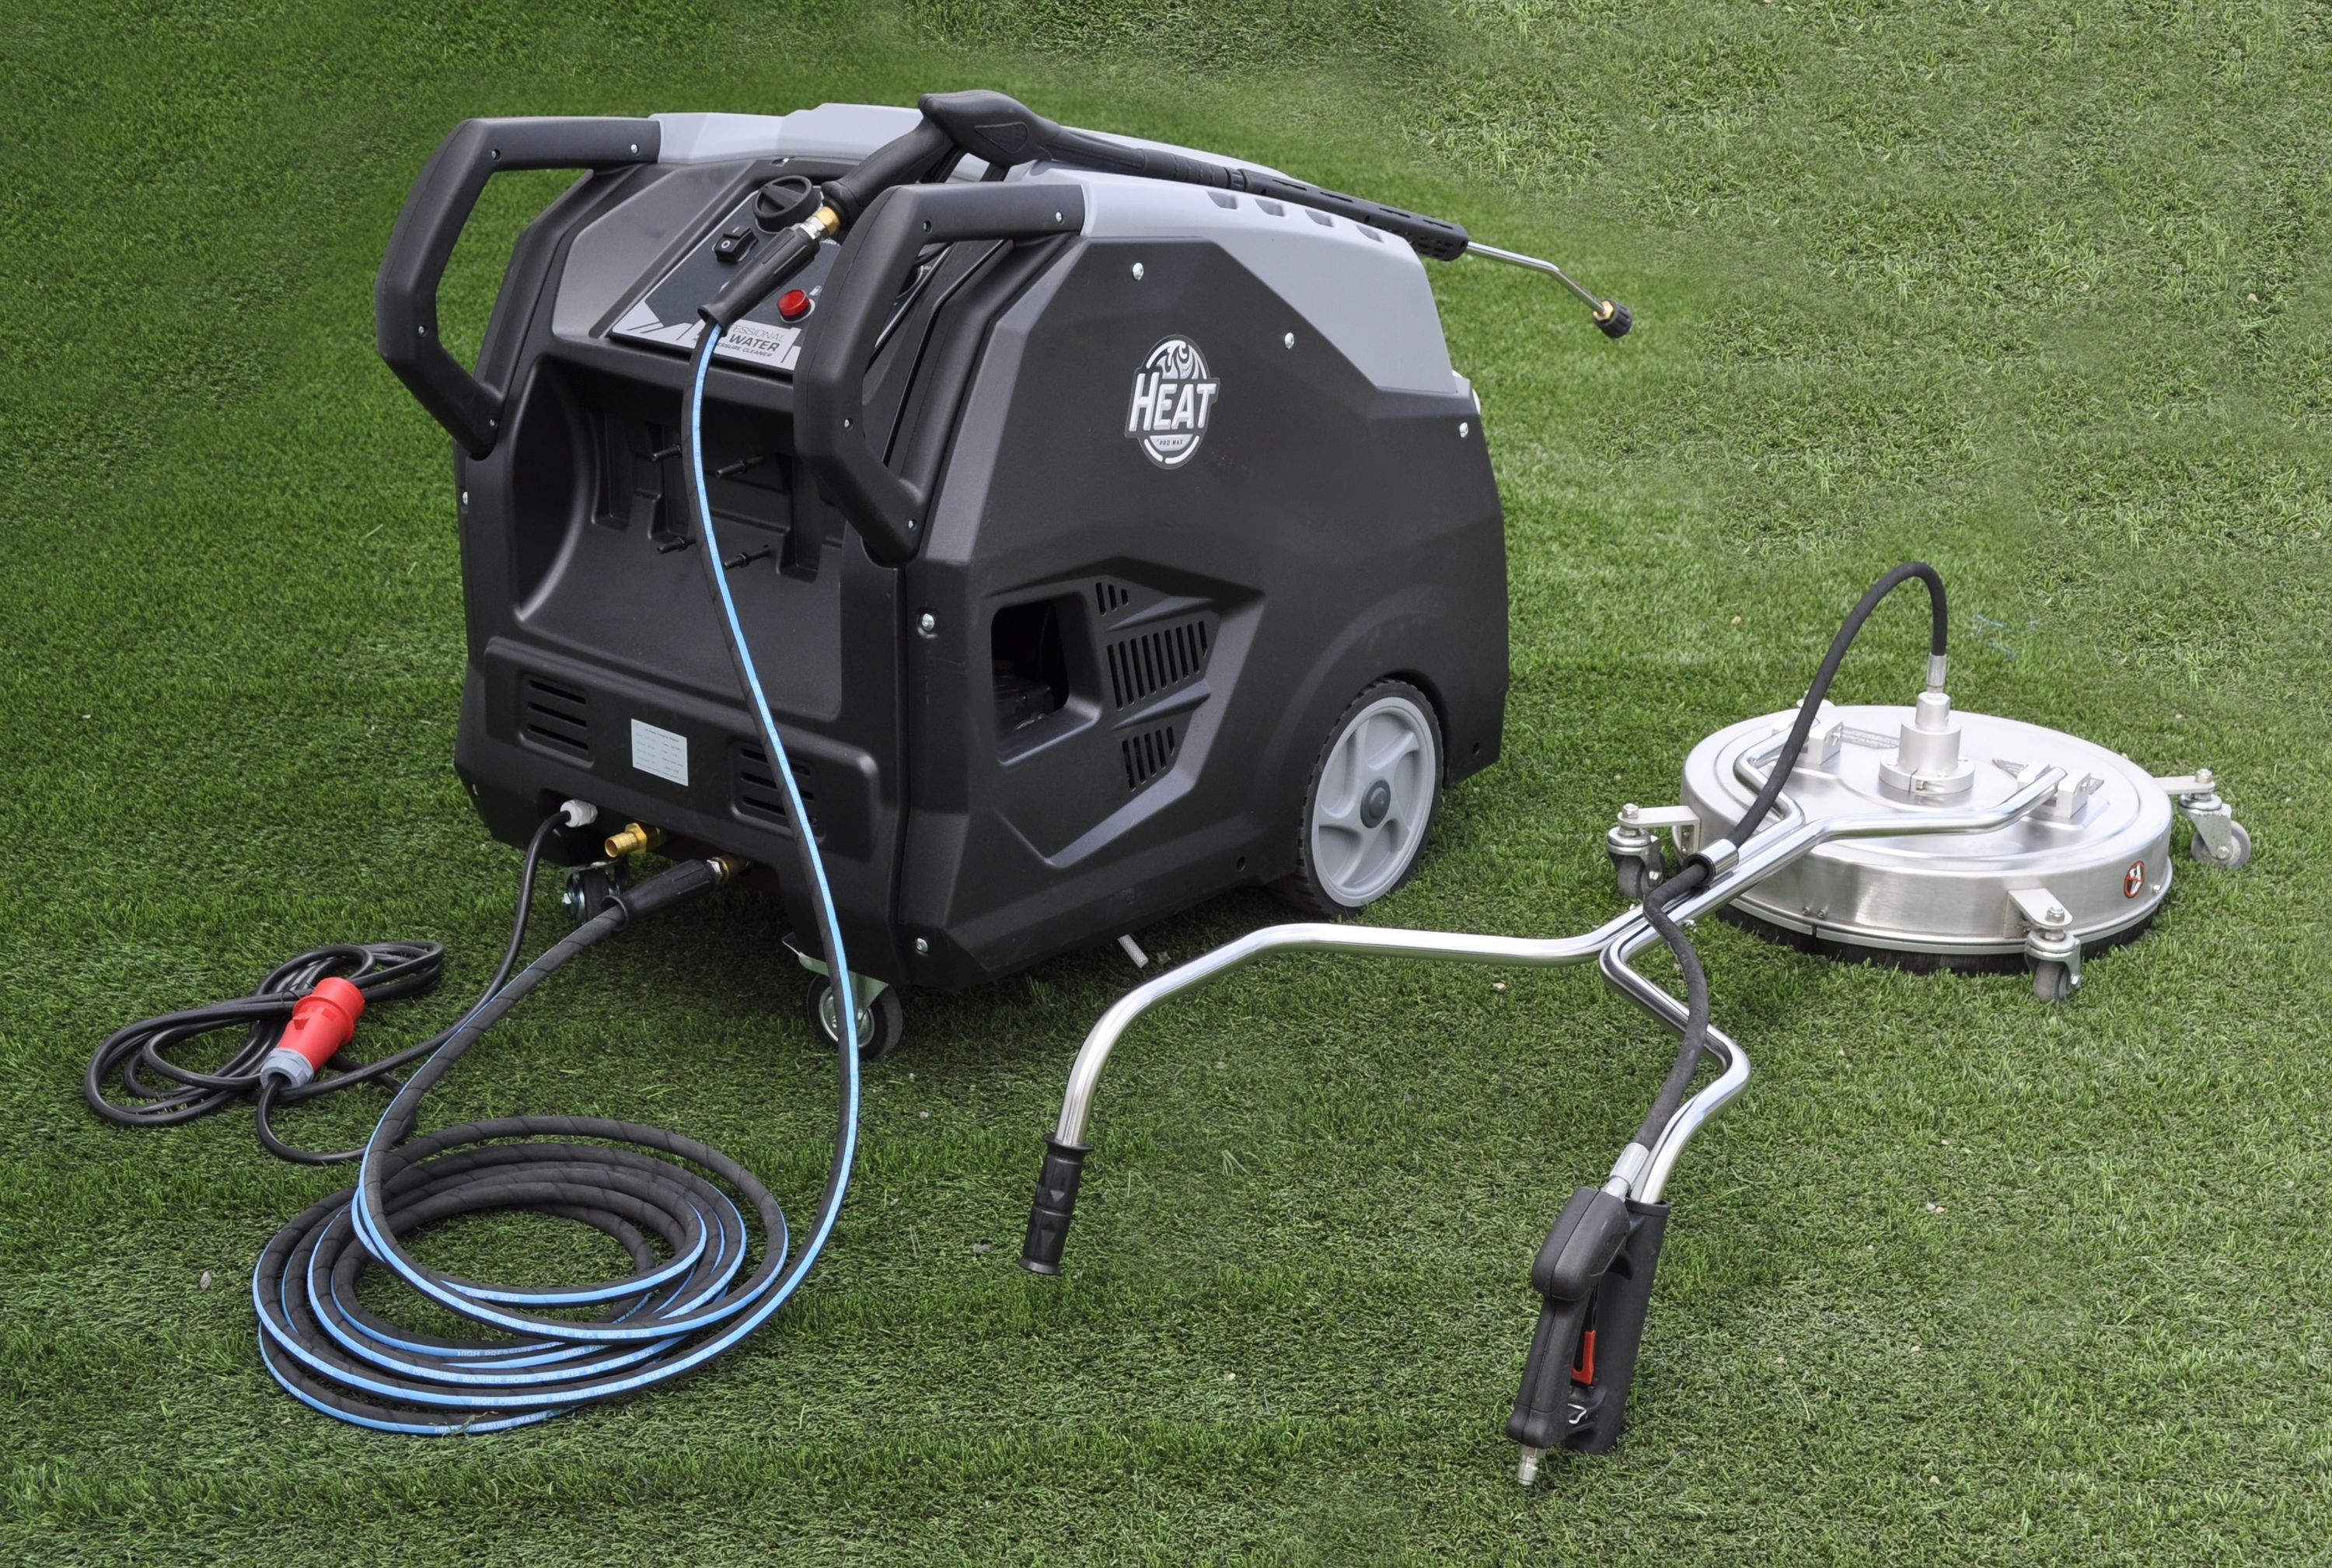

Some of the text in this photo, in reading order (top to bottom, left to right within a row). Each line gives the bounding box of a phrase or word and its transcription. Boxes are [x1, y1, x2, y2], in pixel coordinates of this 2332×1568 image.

[729, 334, 780, 352] WATER
[742, 347, 772, 358] CLEANER
[1129, 372, 1217, 431] HEAT
[562, 1348, 585, 1359] HIGH
[468, 1419, 513, 1432] RESSURE
